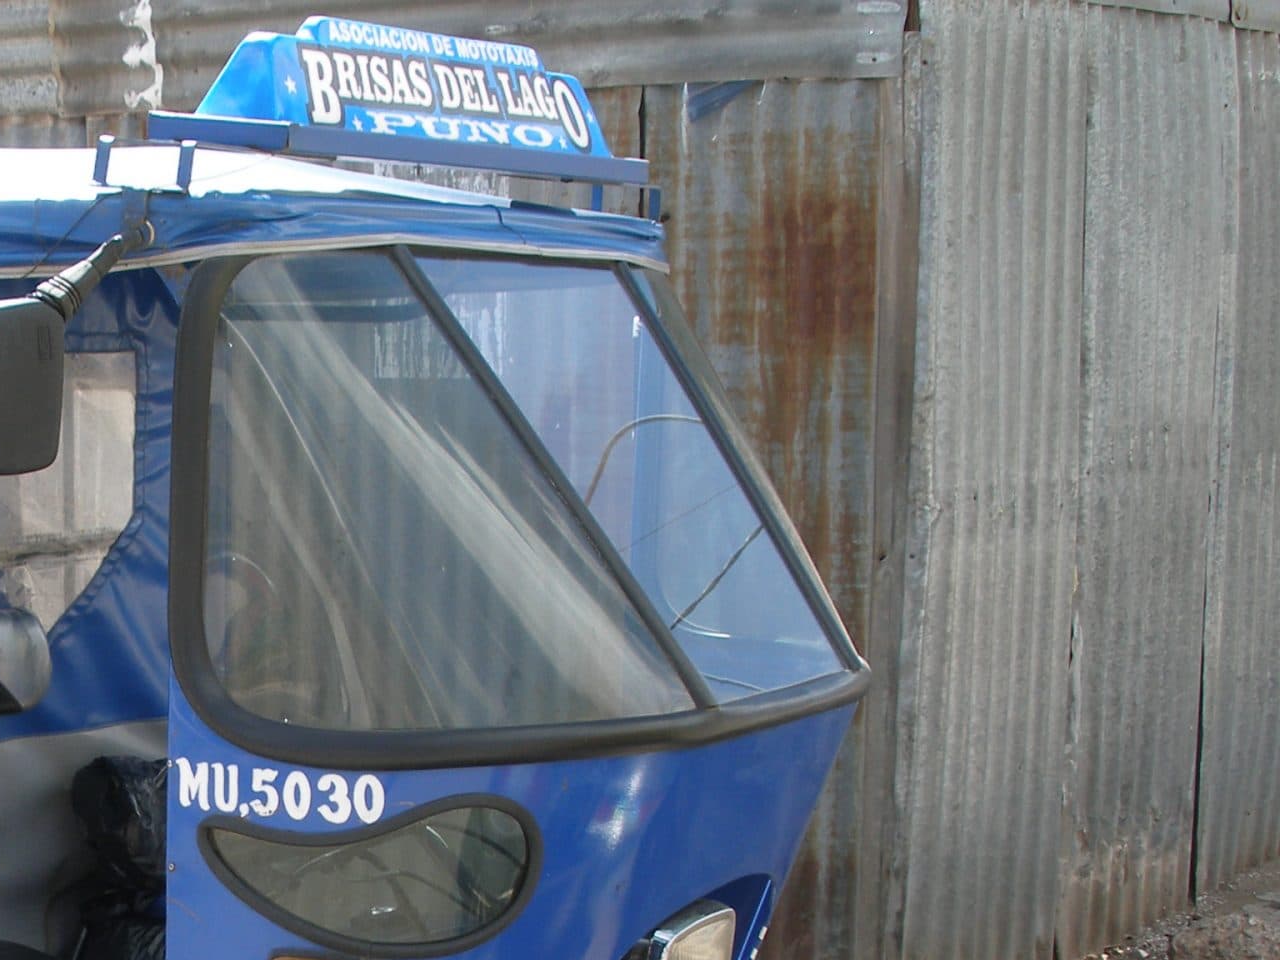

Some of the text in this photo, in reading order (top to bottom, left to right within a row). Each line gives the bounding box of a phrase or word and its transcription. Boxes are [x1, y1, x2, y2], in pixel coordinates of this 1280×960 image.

[329, 20, 540, 67] ASOCIACION DE MOTOTAXIS
[302, 48, 589, 148] BRISAS DEL LAGO
[366, 110, 554, 147] PUNO
